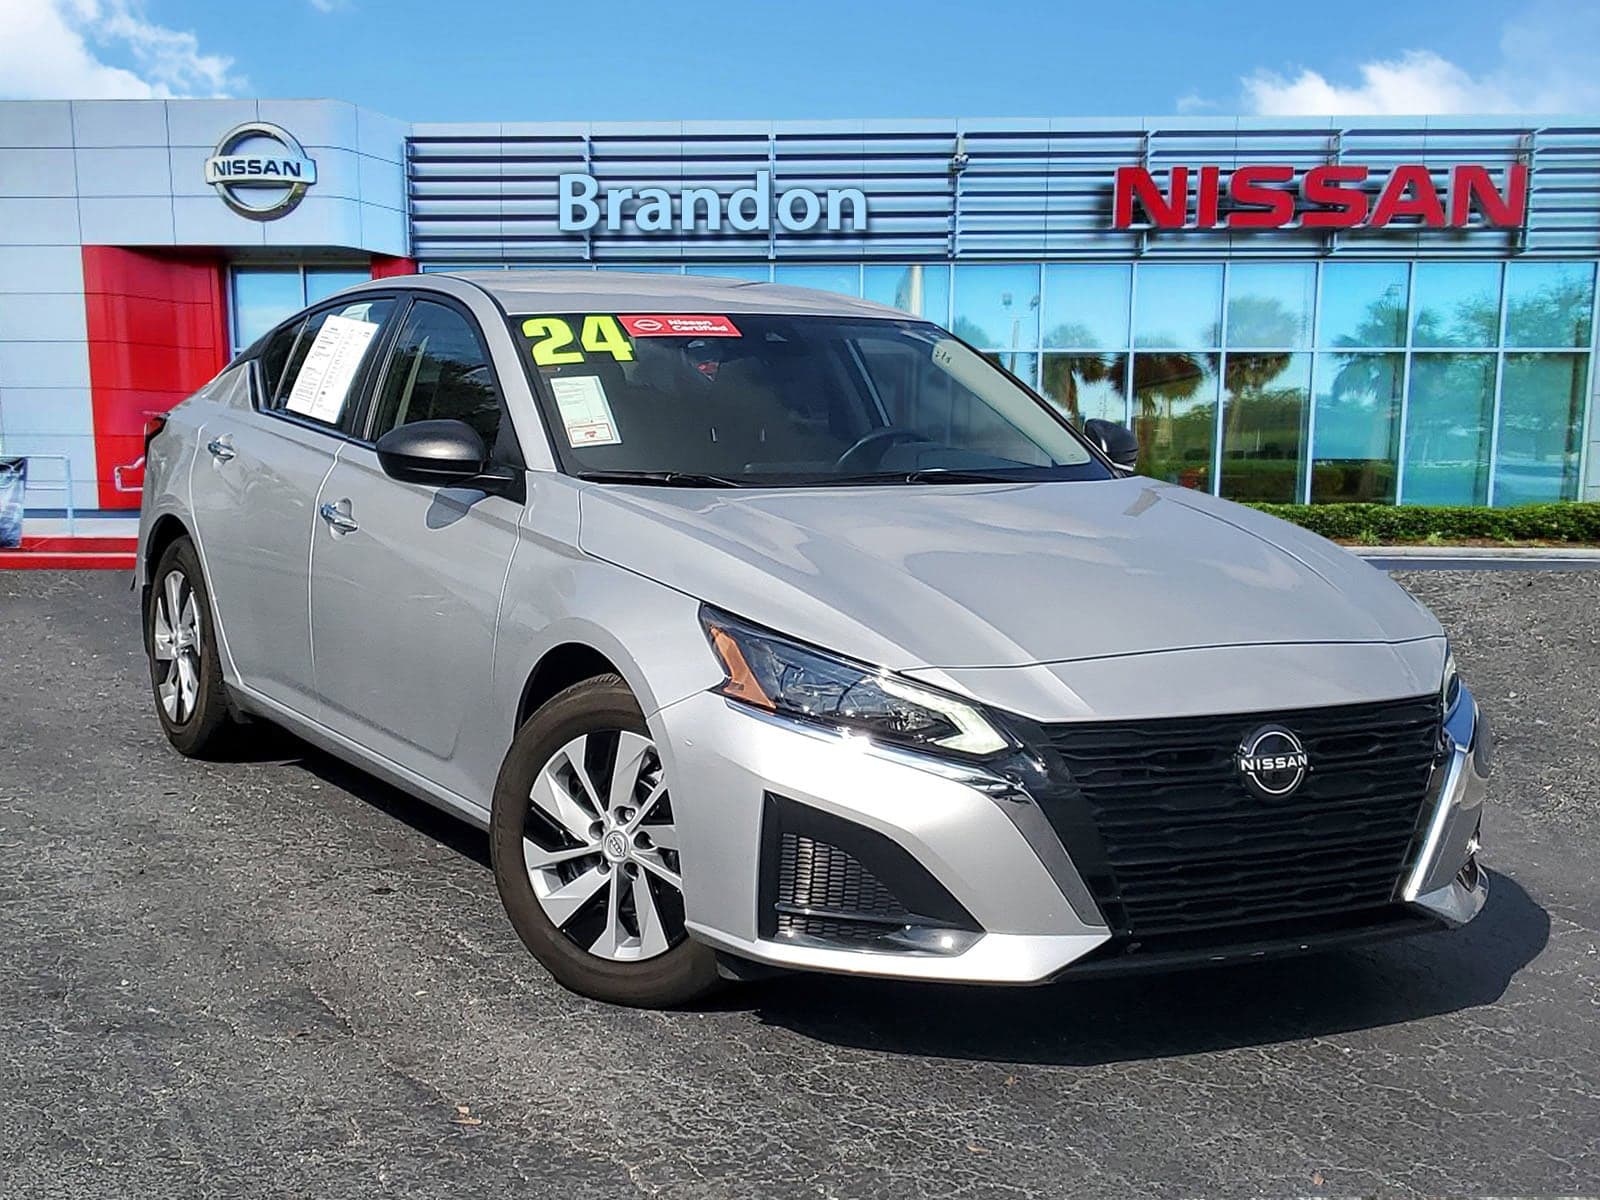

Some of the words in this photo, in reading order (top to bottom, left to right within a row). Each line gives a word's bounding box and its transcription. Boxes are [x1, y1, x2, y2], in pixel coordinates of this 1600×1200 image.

[213, 159, 301, 177] NISSAN
[559, 170, 867, 232] Brandon
[1113, 165, 1529, 229] NISSAN
[521, 315, 634, 366] 24
[1241, 754, 1308, 771] NISSAN
